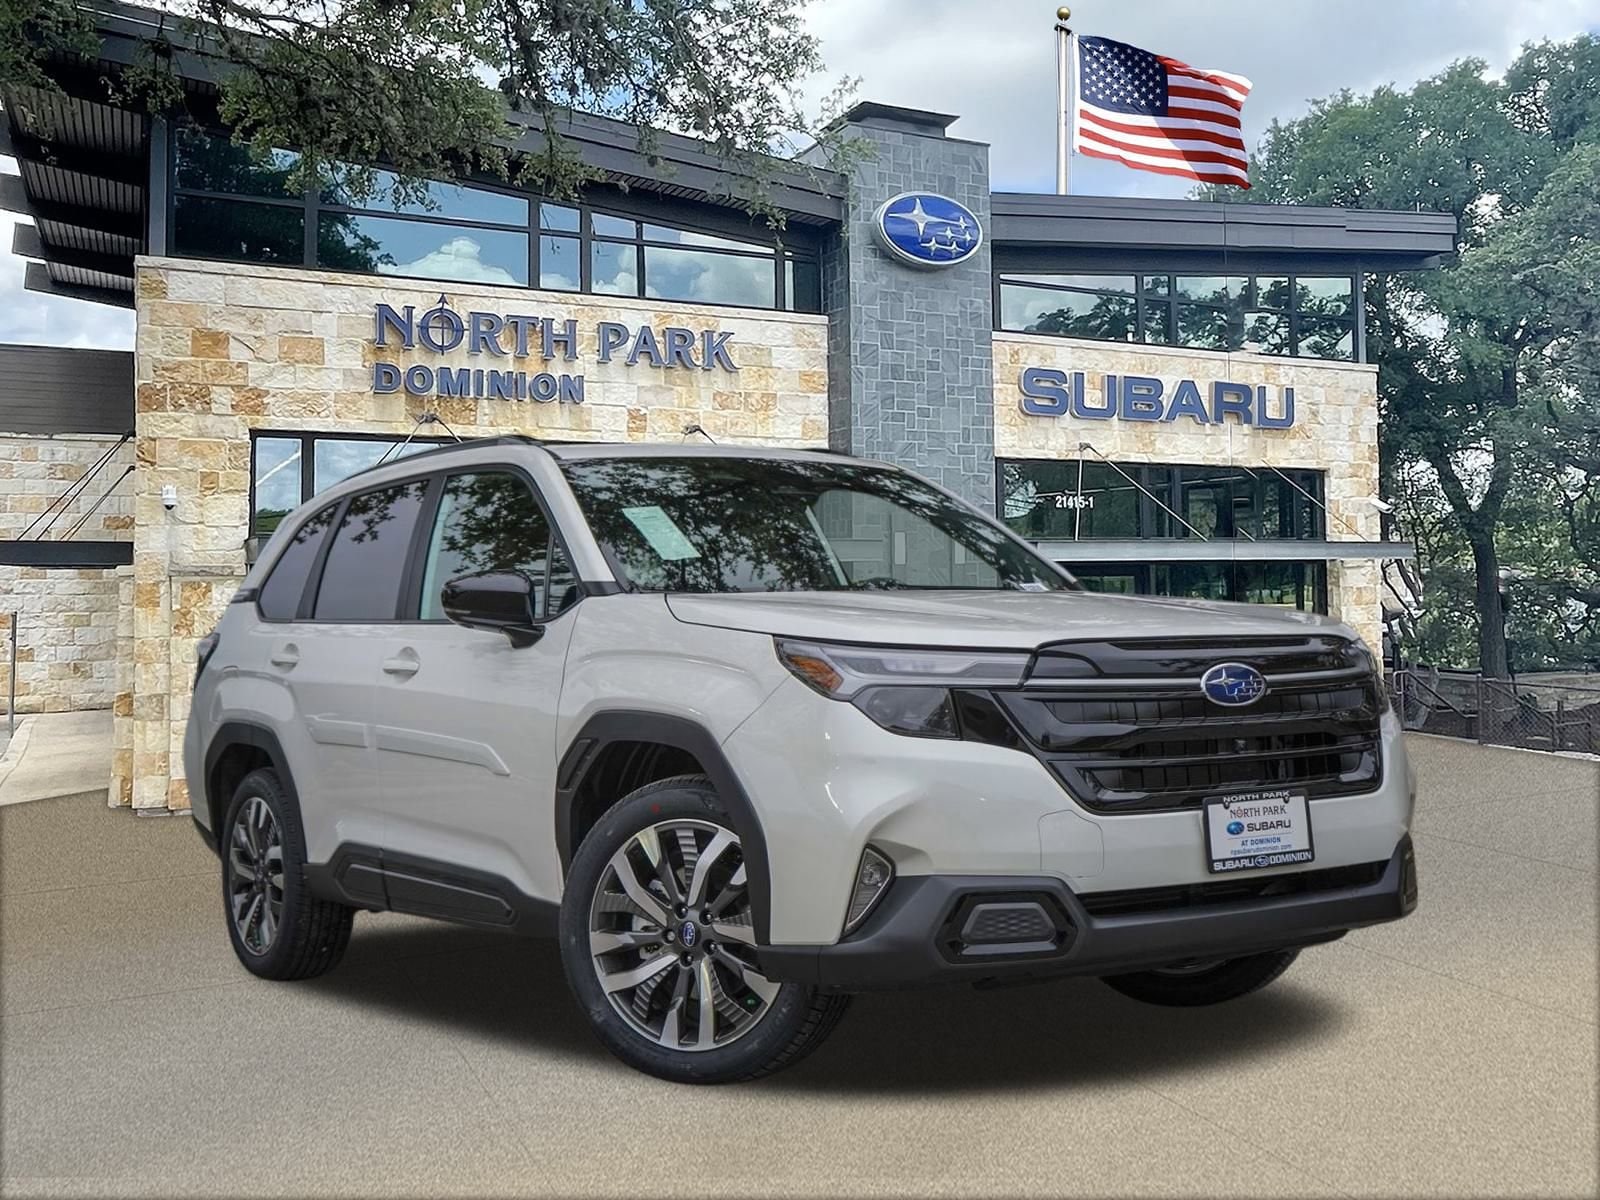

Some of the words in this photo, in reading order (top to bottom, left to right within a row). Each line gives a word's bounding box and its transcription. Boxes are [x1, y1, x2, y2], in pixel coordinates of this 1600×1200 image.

[374, 292, 580, 361] NORTH
[596, 321, 742, 373] PARK
[373, 361, 586, 404] DOMINION
[1018, 366, 1295, 430] SUBARU
[1223, 792, 1260, 803] NORTH
[1262, 790, 1290, 799] PARK
[1229, 806, 1261, 819] NORTH
[1262, 804, 1287, 816] PARK
[1246, 819, 1292, 832] SUBARU
[1241, 839, 1249, 847] AT
[1250, 836, 1281, 846] DOMINION
[1213, 858, 1255, 871] SUBARU
[1269, 851, 1313, 865] DOMINION
